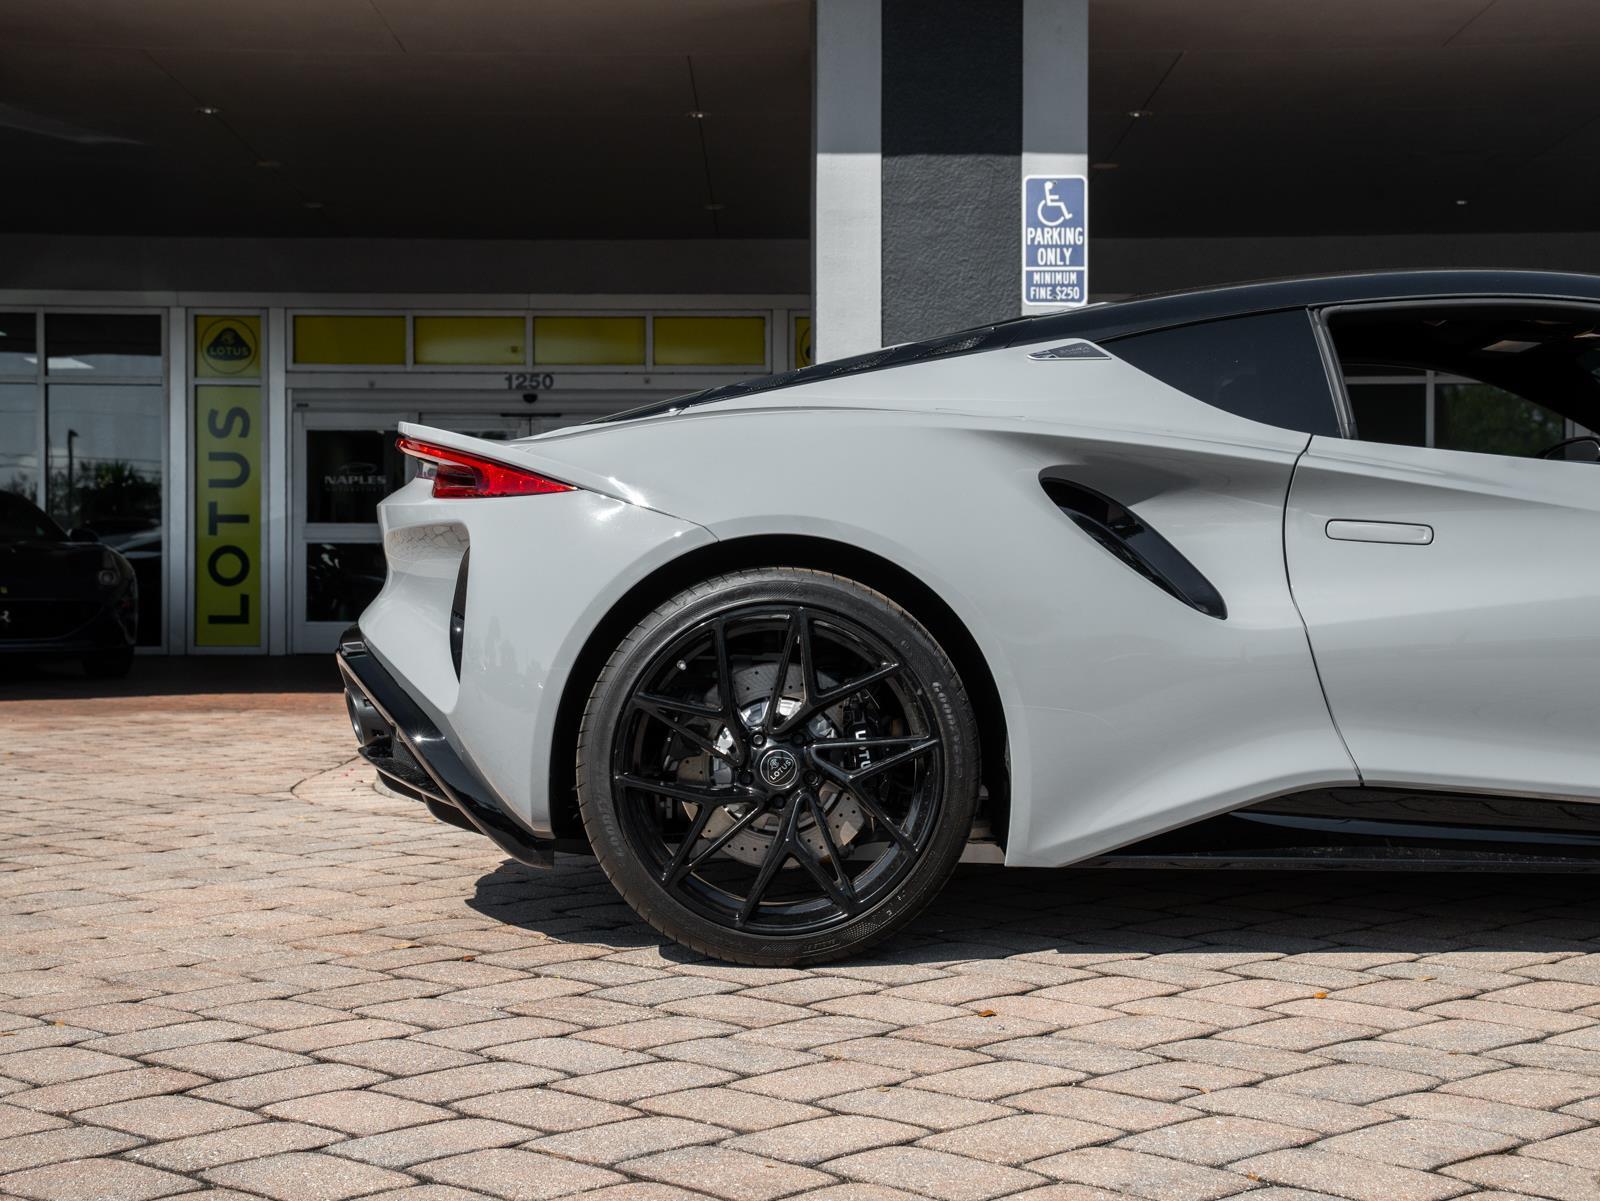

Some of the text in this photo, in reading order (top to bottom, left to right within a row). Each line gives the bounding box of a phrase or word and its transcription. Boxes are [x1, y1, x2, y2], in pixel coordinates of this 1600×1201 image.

[1026, 227, 1083, 245] PARKING
[1037, 247, 1072, 265] ONLY
[1033, 272, 1077, 284] MINIMUM
[1030, 286, 1080, 300] FINE $250
[209, 346, 250, 356] LOTUS
[504, 373, 554, 390] 1250
[324, 475, 387, 485] NAPLES
[208, 406, 250, 624] LOTUS
[770, 759, 792, 781] LOTUS
